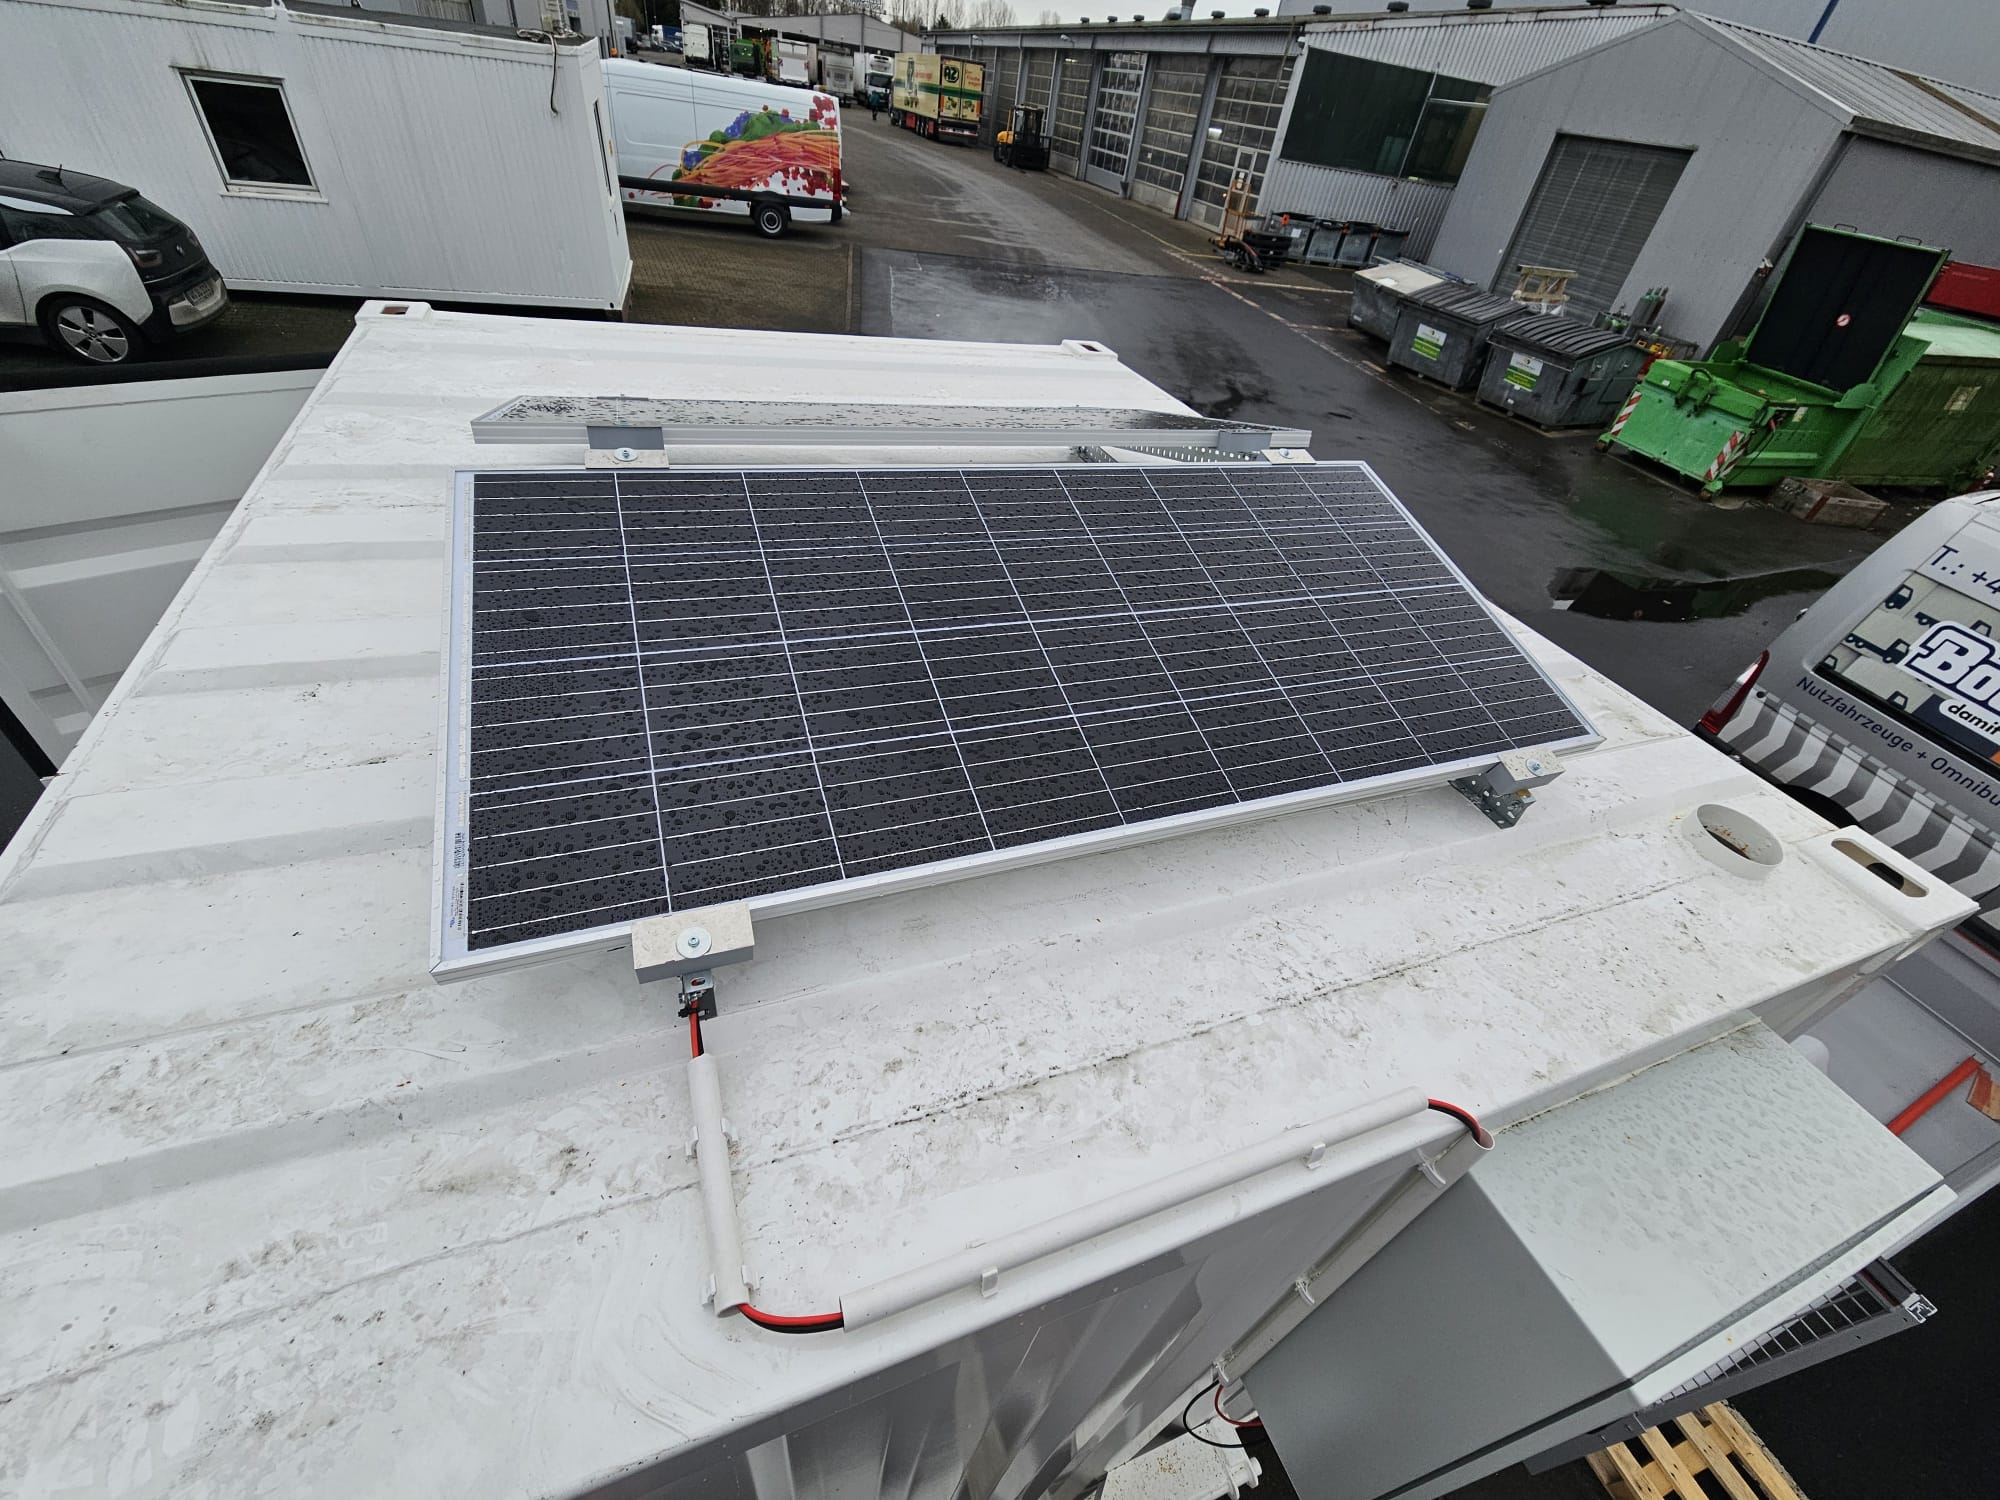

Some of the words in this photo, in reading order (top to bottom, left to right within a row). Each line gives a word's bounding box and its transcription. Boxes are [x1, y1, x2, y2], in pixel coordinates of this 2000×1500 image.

[1931, 544, 1965, 575] T.:
[1904, 625, 2000, 717] Bo
[1796, 676, 1913, 752] Nutzfahrzeuge
[1916, 751, 1927, 760] +
